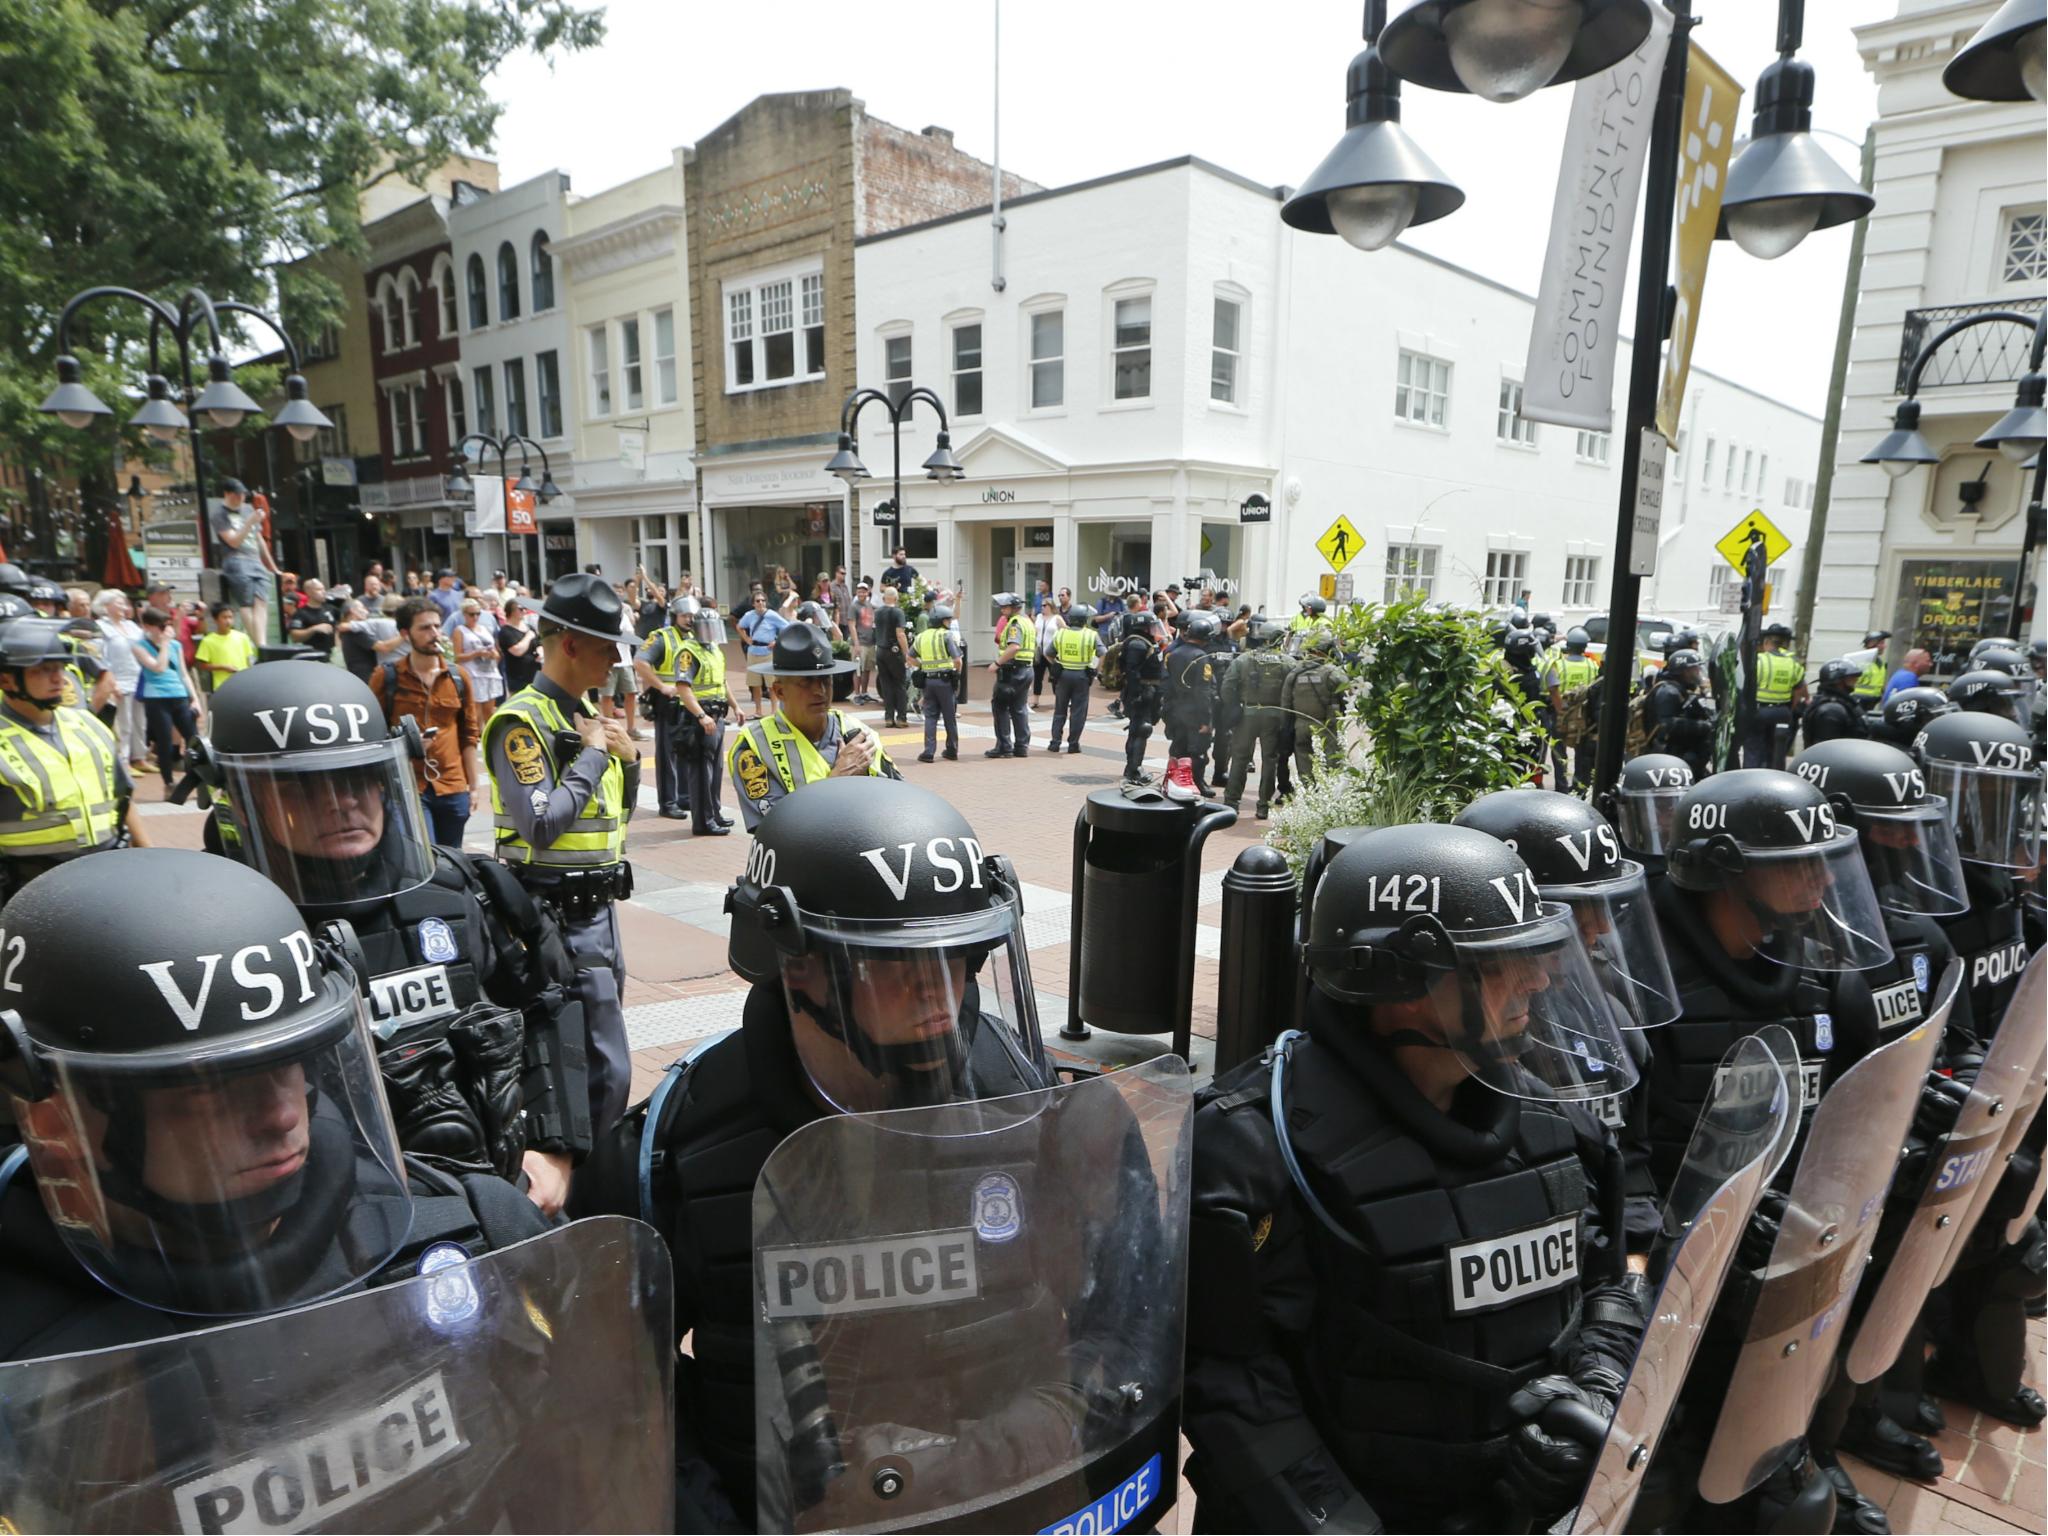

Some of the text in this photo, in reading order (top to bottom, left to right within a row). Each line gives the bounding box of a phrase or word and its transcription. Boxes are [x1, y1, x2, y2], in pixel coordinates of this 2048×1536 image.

[1559, 69, 1623, 399] COMMUNITY
[1641, 458, 1663, 480] CAUTION
[981, 490, 1015, 503] UNION
[1241, 506, 1269, 516] UNION
[1639, 487, 1661, 509] VEHICLE
[511, 510, 531, 525] 50
[1033, 532, 1050, 542] 400
[169, 558, 191, 567] PIE
[1913, 576, 2003, 589] TIMBERLAKE
[1922, 614, 1980, 626] DRUGS
[1064, 649, 1079, 657] POLICE
[1896, 700, 1918, 713] 429
[254, 703, 370, 749] VSP
[1968, 741, 2032, 771] VSP
[1646, 768, 1694, 787] VSP
[1797, 762, 1830, 789] 991
[1884, 768, 1927, 802] VS
[1689, 804, 1728, 830] 801
[1786, 803, 1837, 843] VS
[1556, 823, 1623, 872] VS
[860, 838, 985, 901] VSP
[1368, 874, 1441, 913] 1421
[1973, 942, 2028, 988] POLIC
[138, 930, 316, 1031] VSP
[369, 974, 447, 1022] LICE
[1877, 988, 1918, 1022] LICE
[777, 1242, 970, 1307] POLICE
[1459, 1228, 1574, 1300] POLICE
[193, 1386, 450, 1536] POLICE
